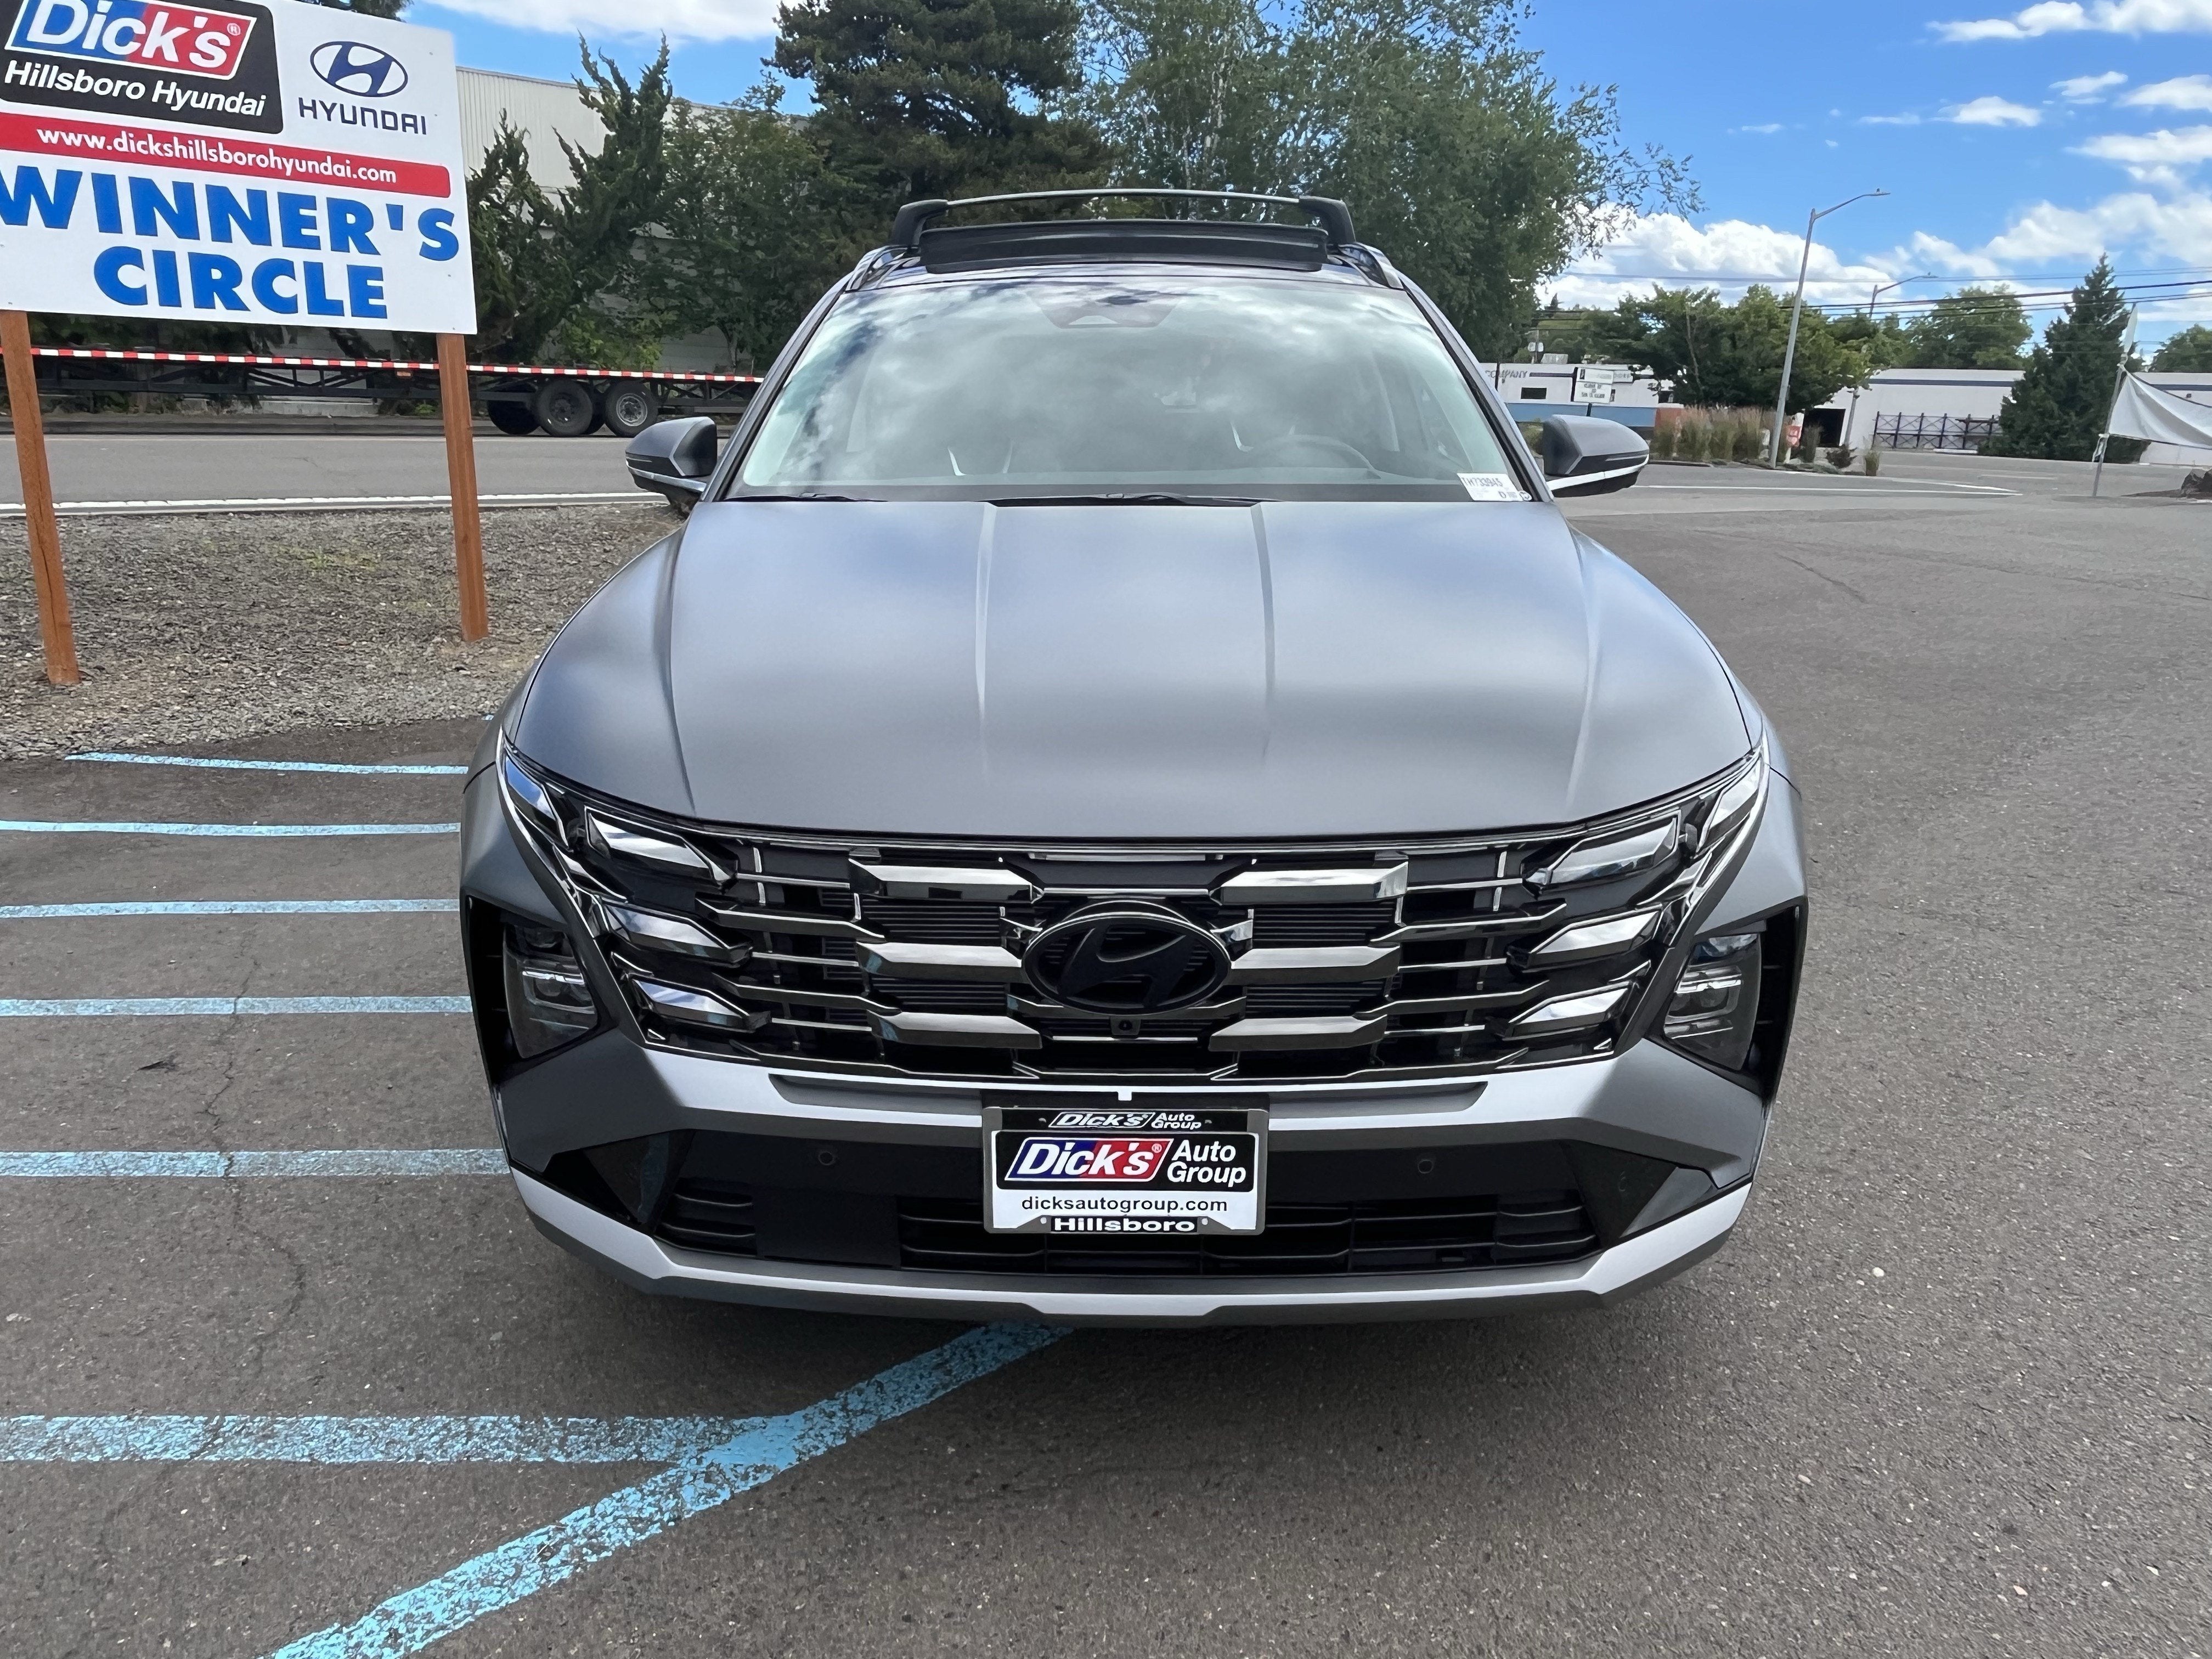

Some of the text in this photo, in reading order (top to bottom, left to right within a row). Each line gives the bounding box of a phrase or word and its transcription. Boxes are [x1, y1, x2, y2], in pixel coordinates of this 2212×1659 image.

[4, 60, 267, 116] Hillsboro Hyundai
[298, 97, 427, 135] HYUNDAI
[36, 128, 397, 184] www.dickshillsborohyundai.com
[0, 166, 459, 262] WINNER'S
[94, 245, 388, 319] CIRCLE
[1057, 1113, 1143, 1127] Dick's
[1152, 1120, 1201, 1130] Group
[1155, 1113, 1195, 1122] Auto
[1017, 1142, 1154, 1176] Dick's
[1172, 1139, 1236, 1162] Auto
[1167, 1161, 1246, 1188] Group
[1022, 1197, 1227, 1213] dicksautogroup.com
[1054, 1217, 1195, 1232] Hillsboro
